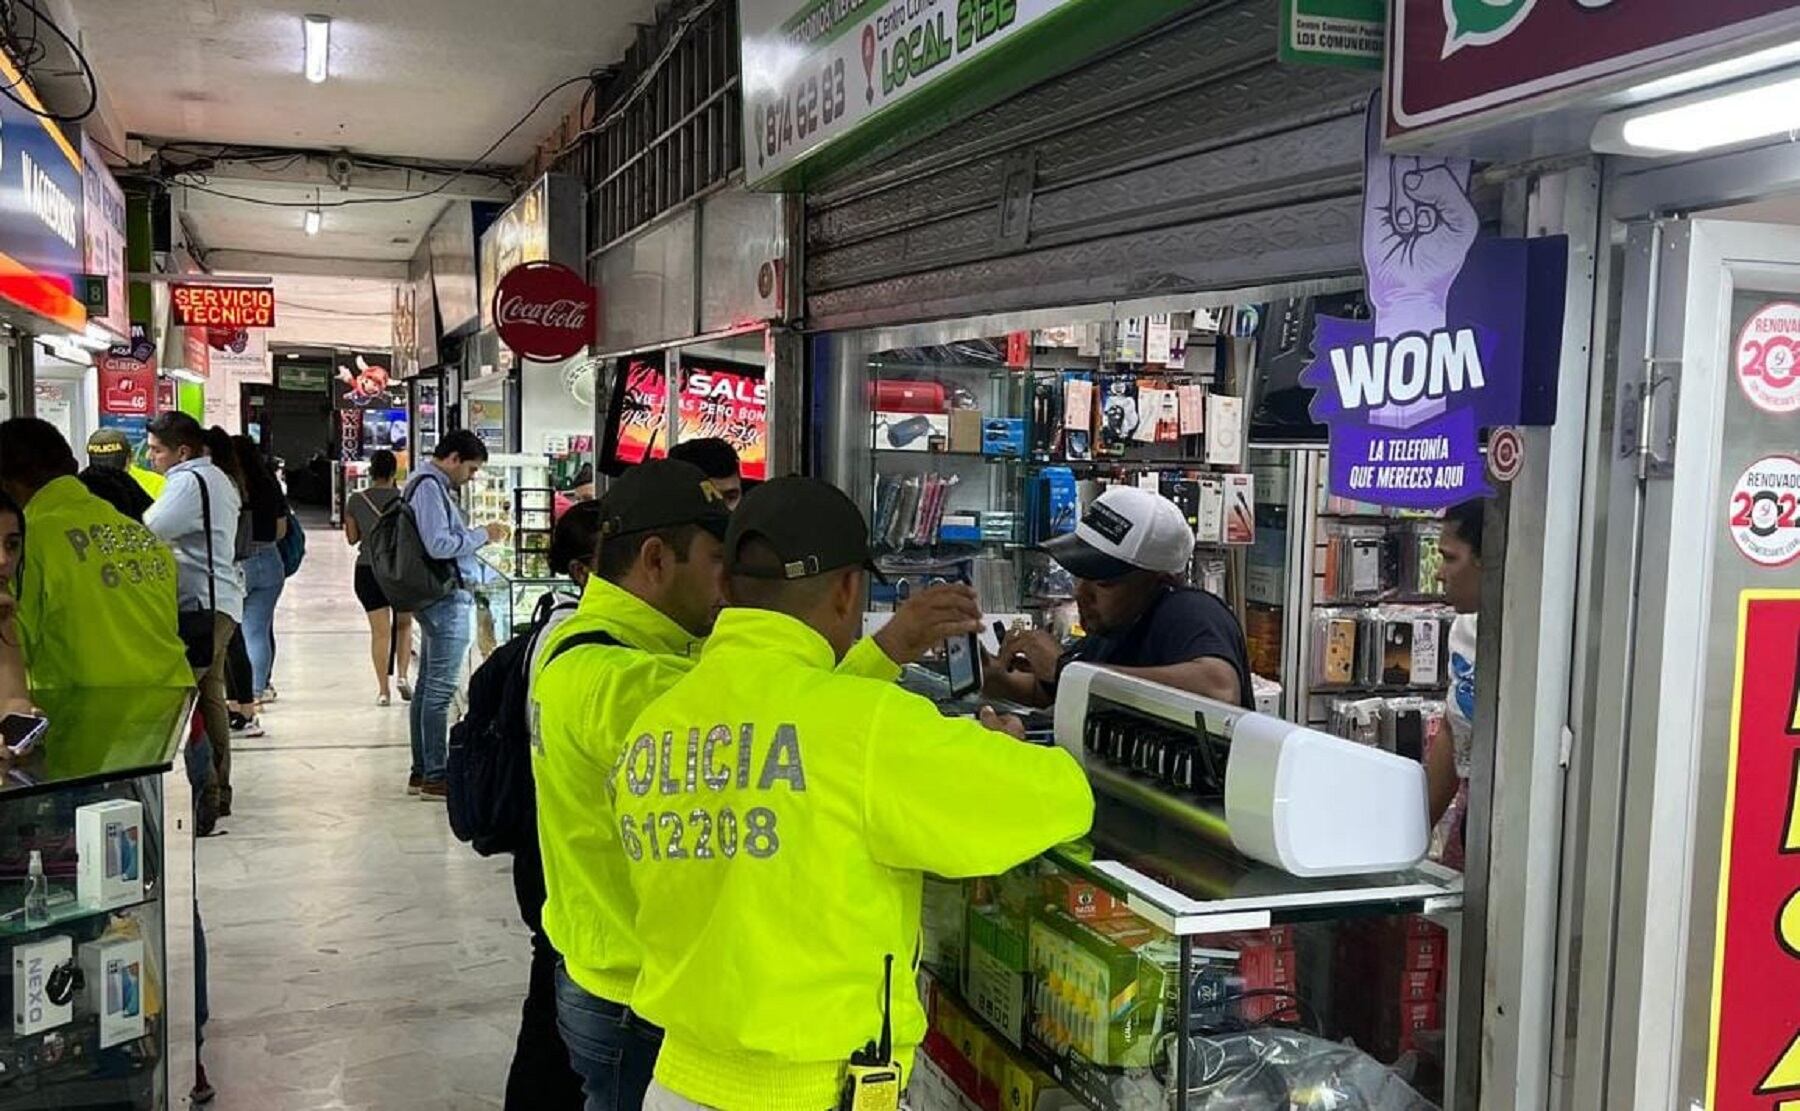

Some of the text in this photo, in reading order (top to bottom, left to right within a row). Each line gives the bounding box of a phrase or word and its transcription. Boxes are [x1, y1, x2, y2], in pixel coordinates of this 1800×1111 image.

[1296, 33, 1316, 46] LOS
[881, 11, 953, 97] LOCAL
[766, 57, 845, 157] 874 62 83
[174, 288, 272, 308] SERVICIO
[179, 305, 270, 325] TECNICO
[501, 294, 590, 330] Coca-Cola
[1330, 328, 1486, 409] WOM
[699, 402, 734, 418] PERO
[1368, 435, 1449, 462] LA TELEFONÍA
[1350, 462, 1465, 489] QUE MERECES AQUÍ
[620, 806, 780, 862] 612208
